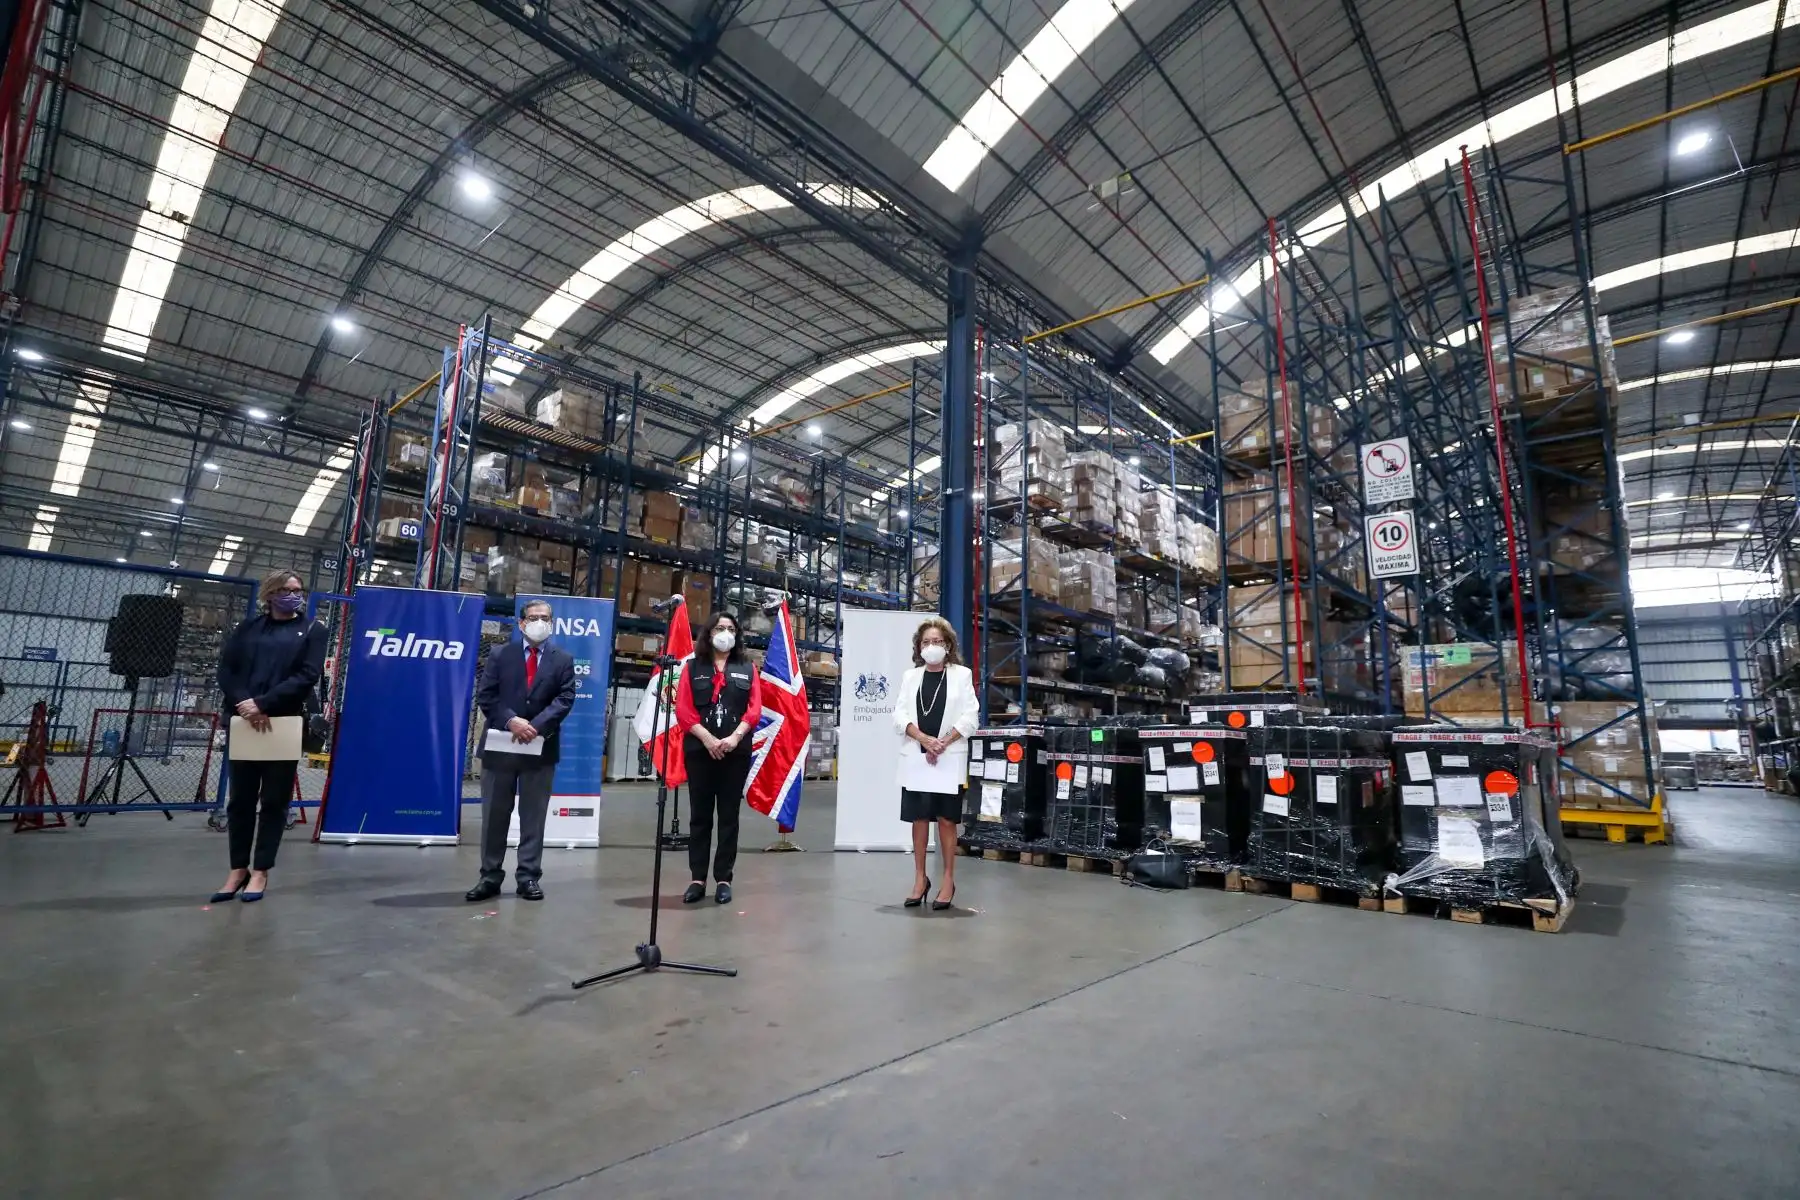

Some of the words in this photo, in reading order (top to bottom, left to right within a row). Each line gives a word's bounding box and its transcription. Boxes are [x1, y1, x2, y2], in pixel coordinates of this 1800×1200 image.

[442, 504, 458, 517] 59
[1014, 511, 1023, 525] 57
[401, 524, 418, 537] 60
[1379, 525, 1402, 543] 10
[895, 536, 905, 548] 58
[352, 547, 366, 558] 61
[1375, 553, 1412, 564] VELOCIDAD
[324, 559, 338, 570] 62
[1377, 561, 1410, 571] MAXIMA
[550, 617, 601, 637] NSA
[365, 628, 465, 660] Talma
[574, 664, 591, 674] OS
[853, 705, 892, 714] Embajada
